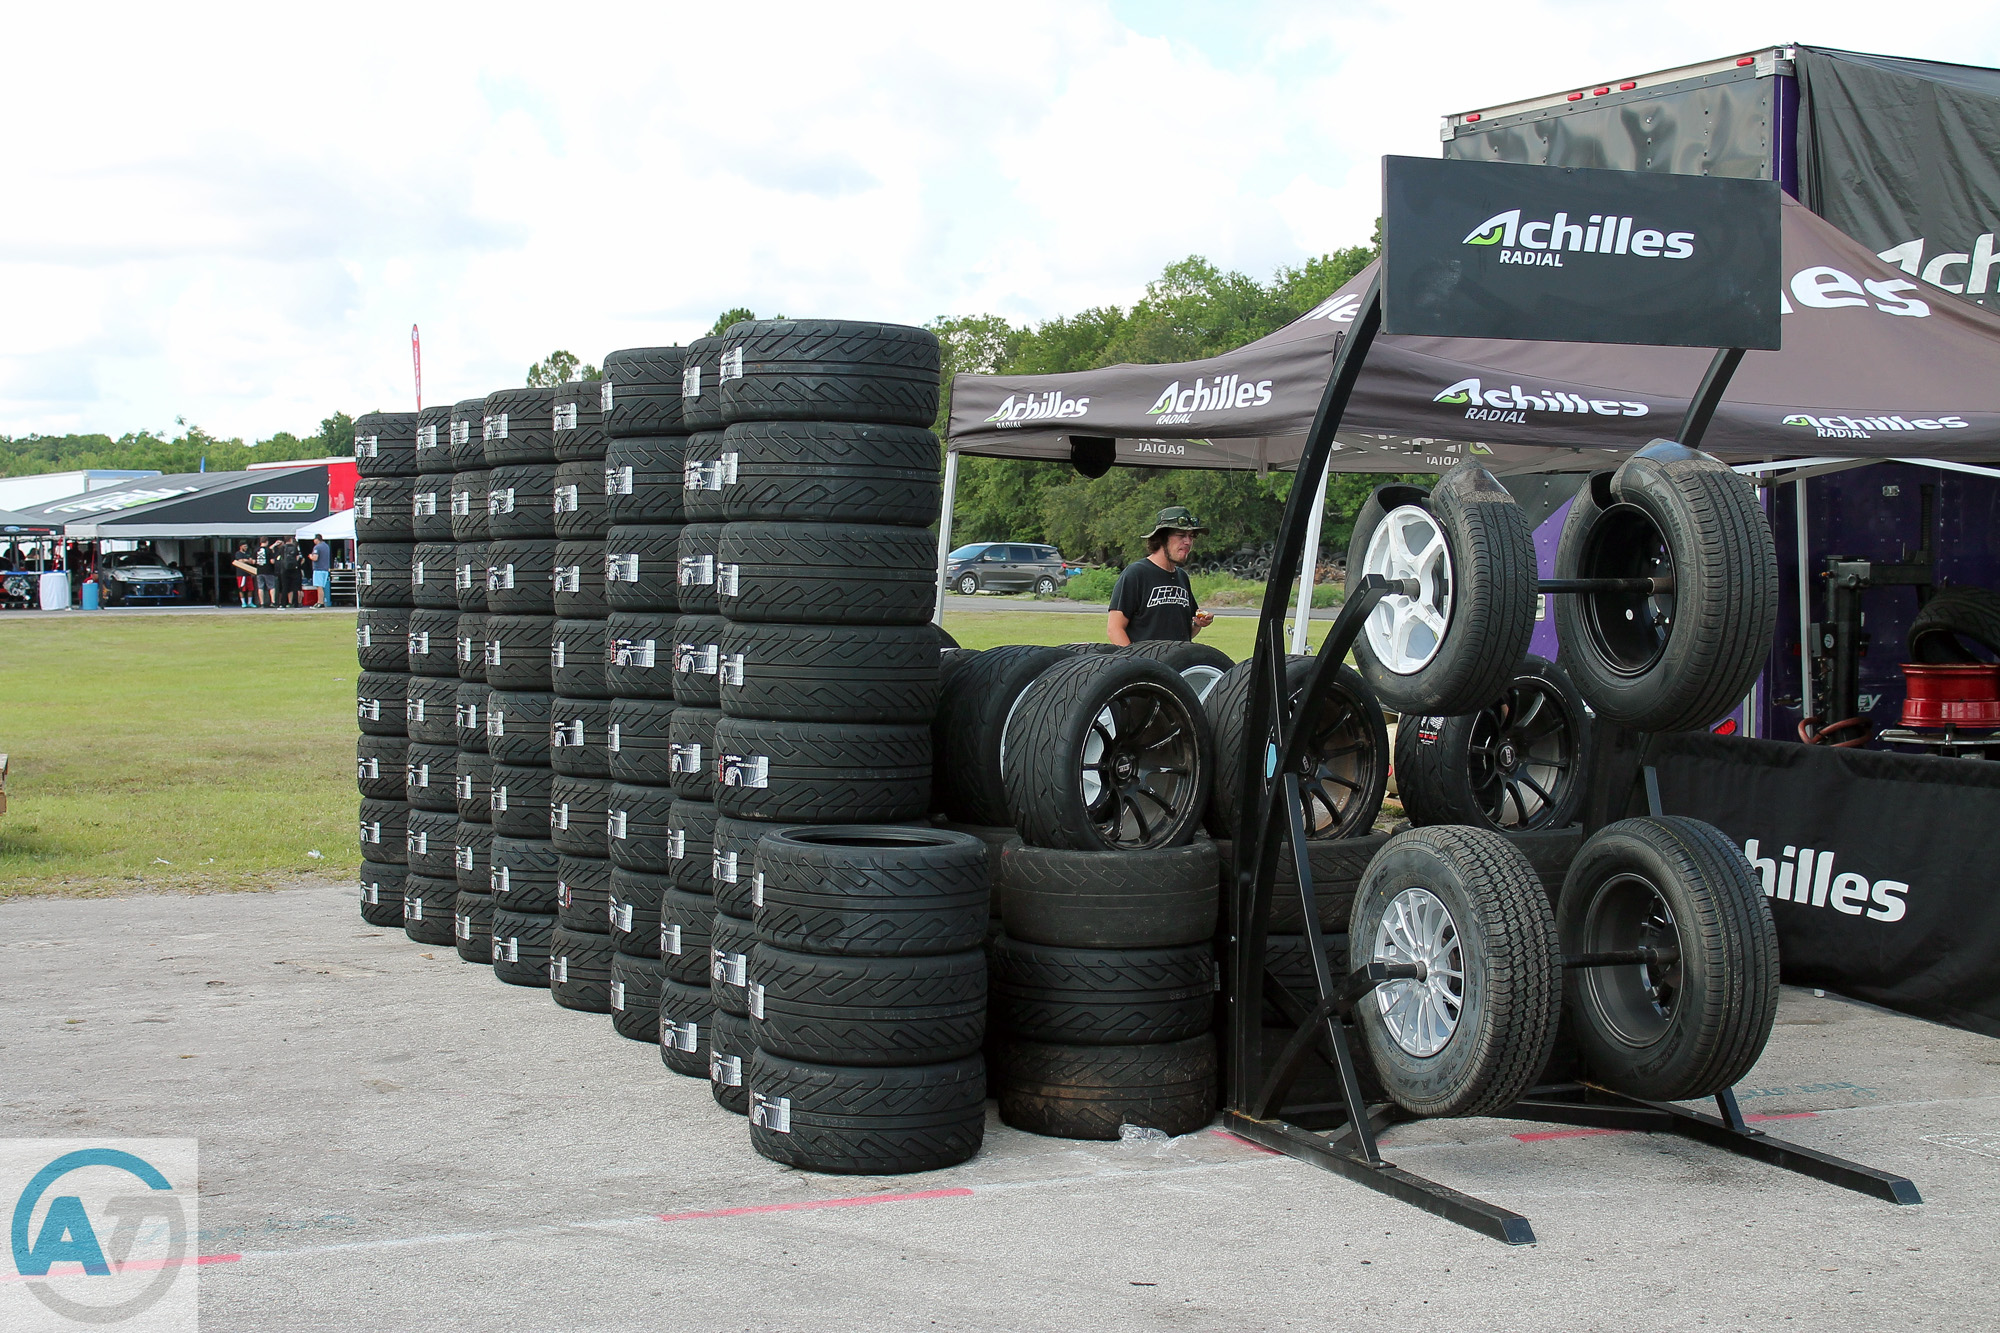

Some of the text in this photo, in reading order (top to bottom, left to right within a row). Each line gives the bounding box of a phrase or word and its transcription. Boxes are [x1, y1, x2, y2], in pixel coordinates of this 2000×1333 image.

[1462, 209, 1695, 261] Achilles
[1499, 249, 1564, 268] RADIAL
[1145, 374, 1273, 416] Achilles
[1433, 378, 1649, 417] Achilles
[984, 391, 1090, 422] Achilles
[1465, 407, 1526, 424] RADIAL
[1155, 413, 1191, 426] RADIAL
[1782, 414, 1970, 431] Achilles
[1816, 427, 1871, 439] RADIAL
[267, 496, 315, 504] FORTUNE
